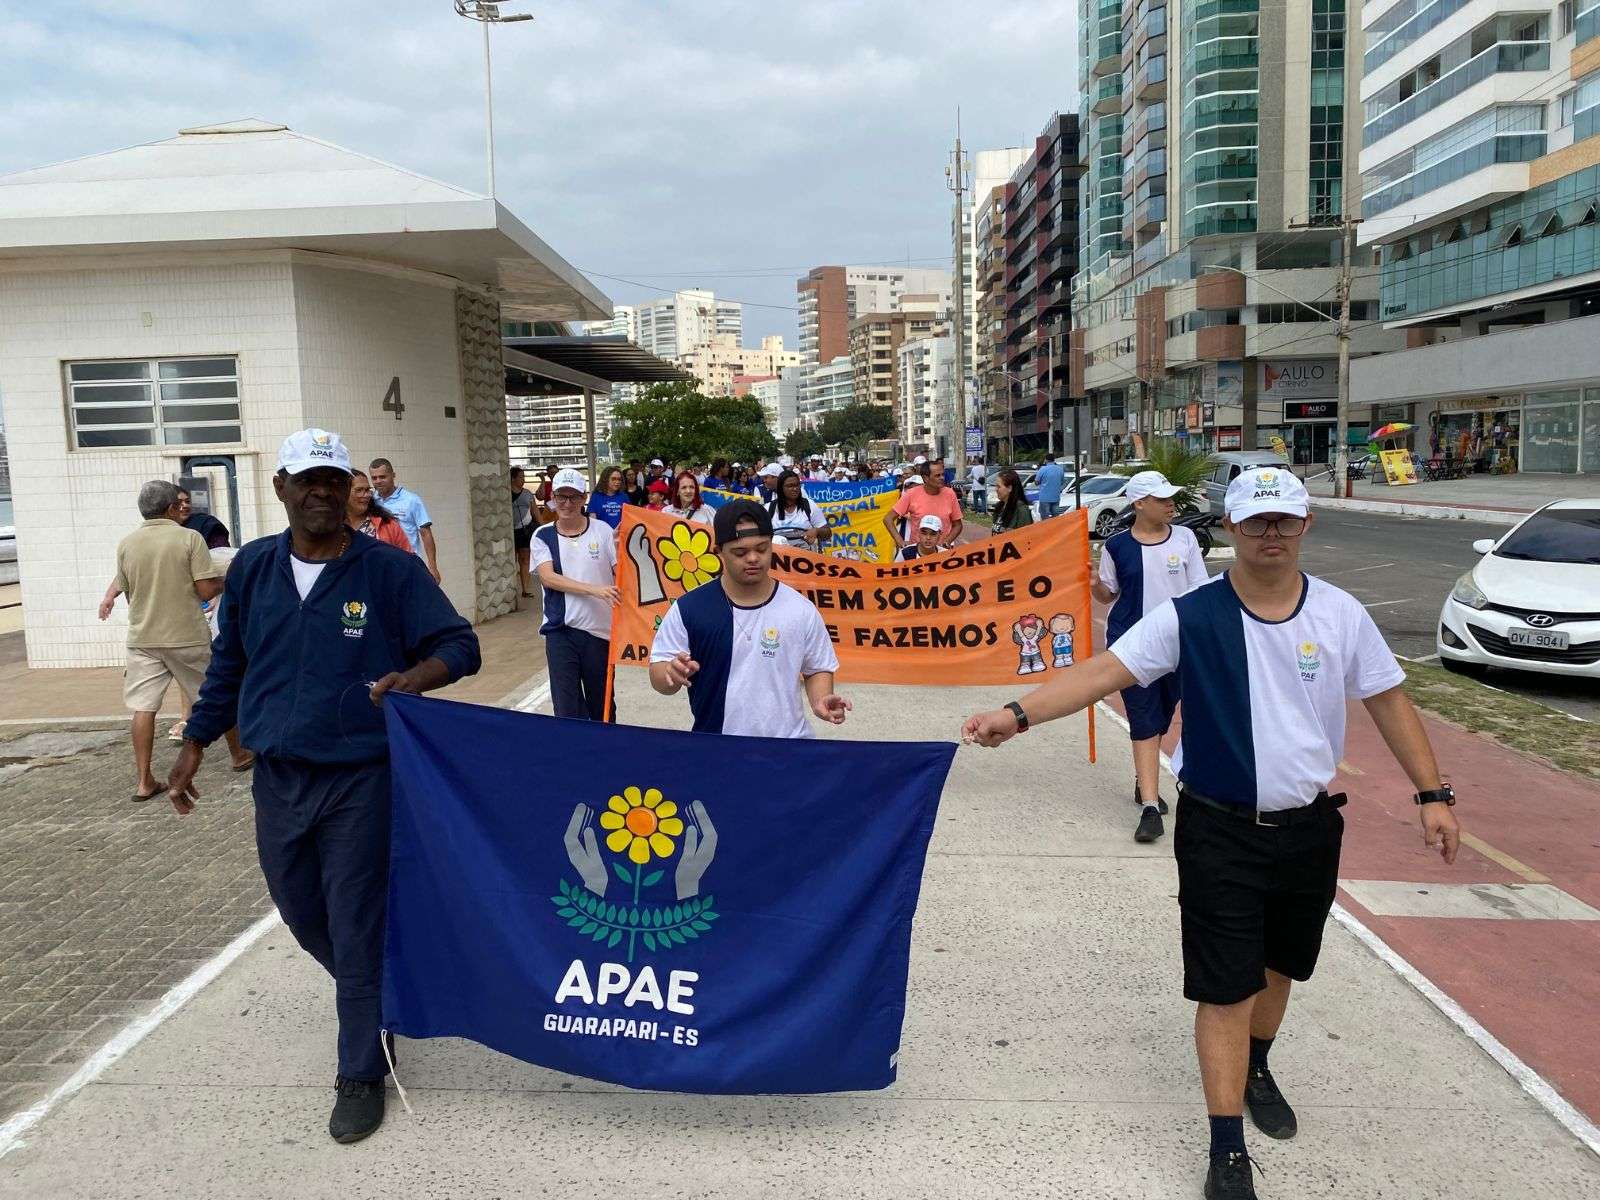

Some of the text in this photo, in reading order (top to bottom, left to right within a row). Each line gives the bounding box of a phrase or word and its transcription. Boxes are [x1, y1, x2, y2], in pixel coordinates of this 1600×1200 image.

[383, 376, 405, 420] 4
[310, 450, 334, 459] APAE
[1253, 490, 1281, 499] APAE
[771, 552, 862, 579] NOSSA
[874, 582, 982, 611] SOMOS
[997, 579, 1015, 602] E
[1029, 575, 1052, 598] O
[343, 627, 364, 636] APAE
[853, 622, 998, 648] FAZEMOS
[554, 959, 699, 1015] APAE
[543, 1013, 699, 1047] GUARAPARI-ES
